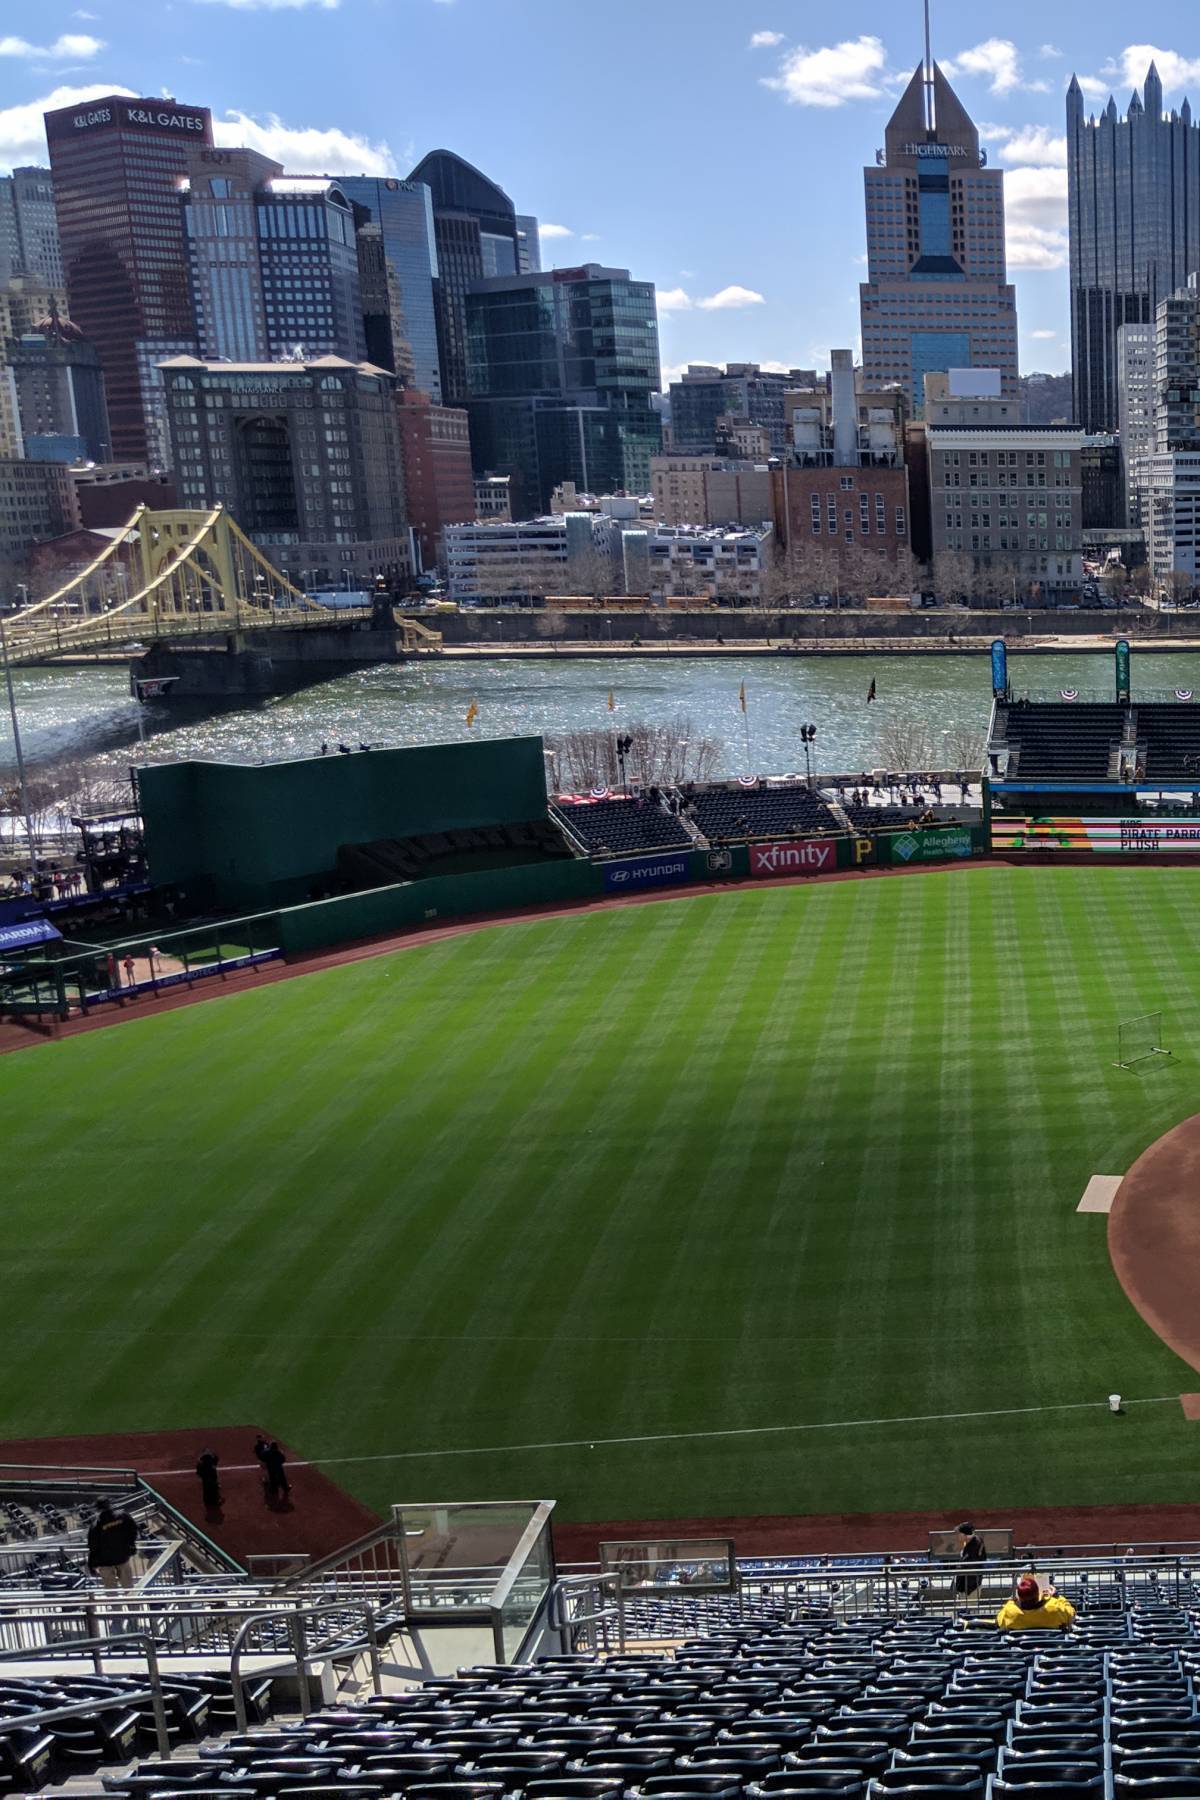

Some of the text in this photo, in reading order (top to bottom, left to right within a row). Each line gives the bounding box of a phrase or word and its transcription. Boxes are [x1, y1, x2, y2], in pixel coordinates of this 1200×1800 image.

[73, 109, 112, 128] K&L GATES
[127, 109, 204, 130] K&L GATES
[905, 143, 968, 157] HIGHMARK
[923, 834, 971, 848] Allegheny
[1120, 829, 1161, 839] PIRATE
[855, 839, 872, 863] P
[1120, 840, 1160, 850] PLUSH
[757, 844, 830, 871] xfinity
[632, 863, 685, 879] HYUNDAI
